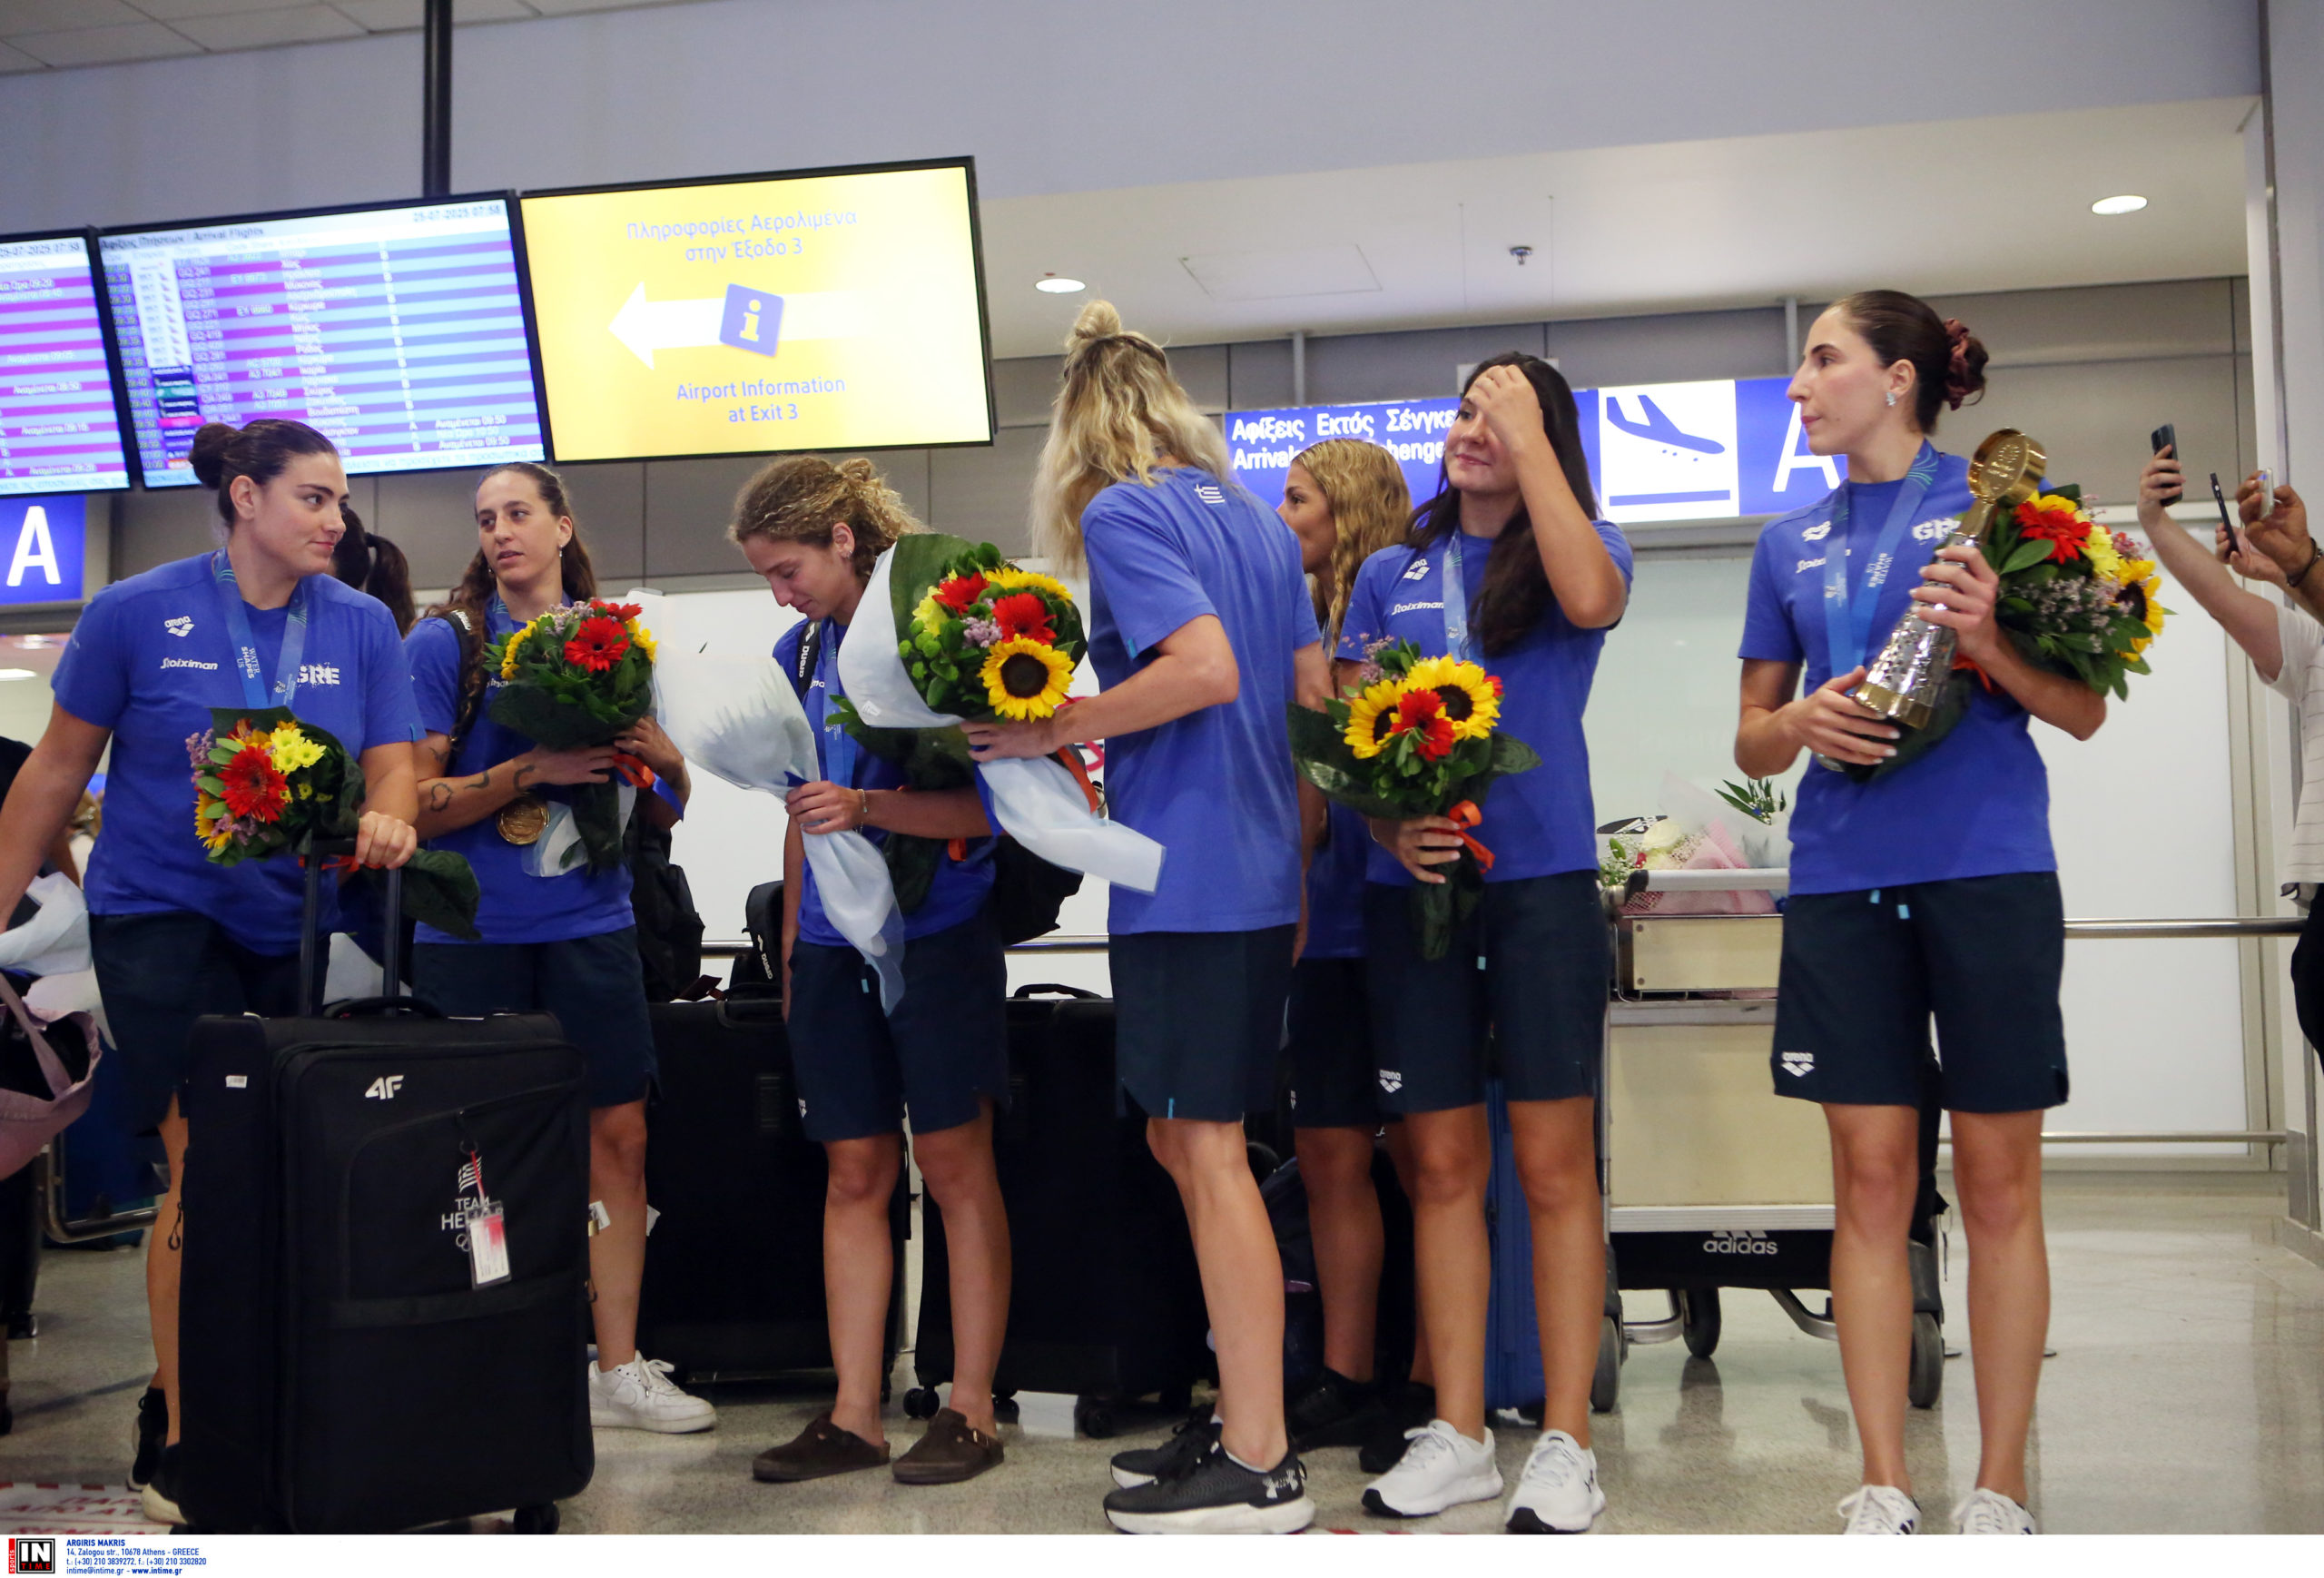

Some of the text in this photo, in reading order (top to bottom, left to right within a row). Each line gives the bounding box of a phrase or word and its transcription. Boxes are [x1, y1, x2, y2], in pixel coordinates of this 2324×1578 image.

[626, 209, 857, 242] Πληροφορίες Αερολιμένα
[685, 237, 803, 264] στην Έξοδο 3
[676, 375, 846, 404] Airport Information
[728, 402, 799, 423] at Exit 3
[1232, 408, 1458, 444] Αφίξεις Εκτός Σένγκε
[1385, 439, 1445, 465] henge
[1772, 401, 1841, 492] A
[1912, 518, 1961, 542] GR
[6, 505, 62, 587] A
[163, 616, 192, 627] arena
[160, 657, 219, 670] Stoiximan
[236, 658, 245, 668] US
[241, 646, 255, 679] SHAPES
[249, 647, 261, 674] WATER
[799, 645, 811, 678] arena
[1780, 1050, 1814, 1063] arena
[365, 1075, 404, 1100] 4F
[1379, 1069, 1402, 1081] arena
[1703, 1236, 1778, 1255] adidas
